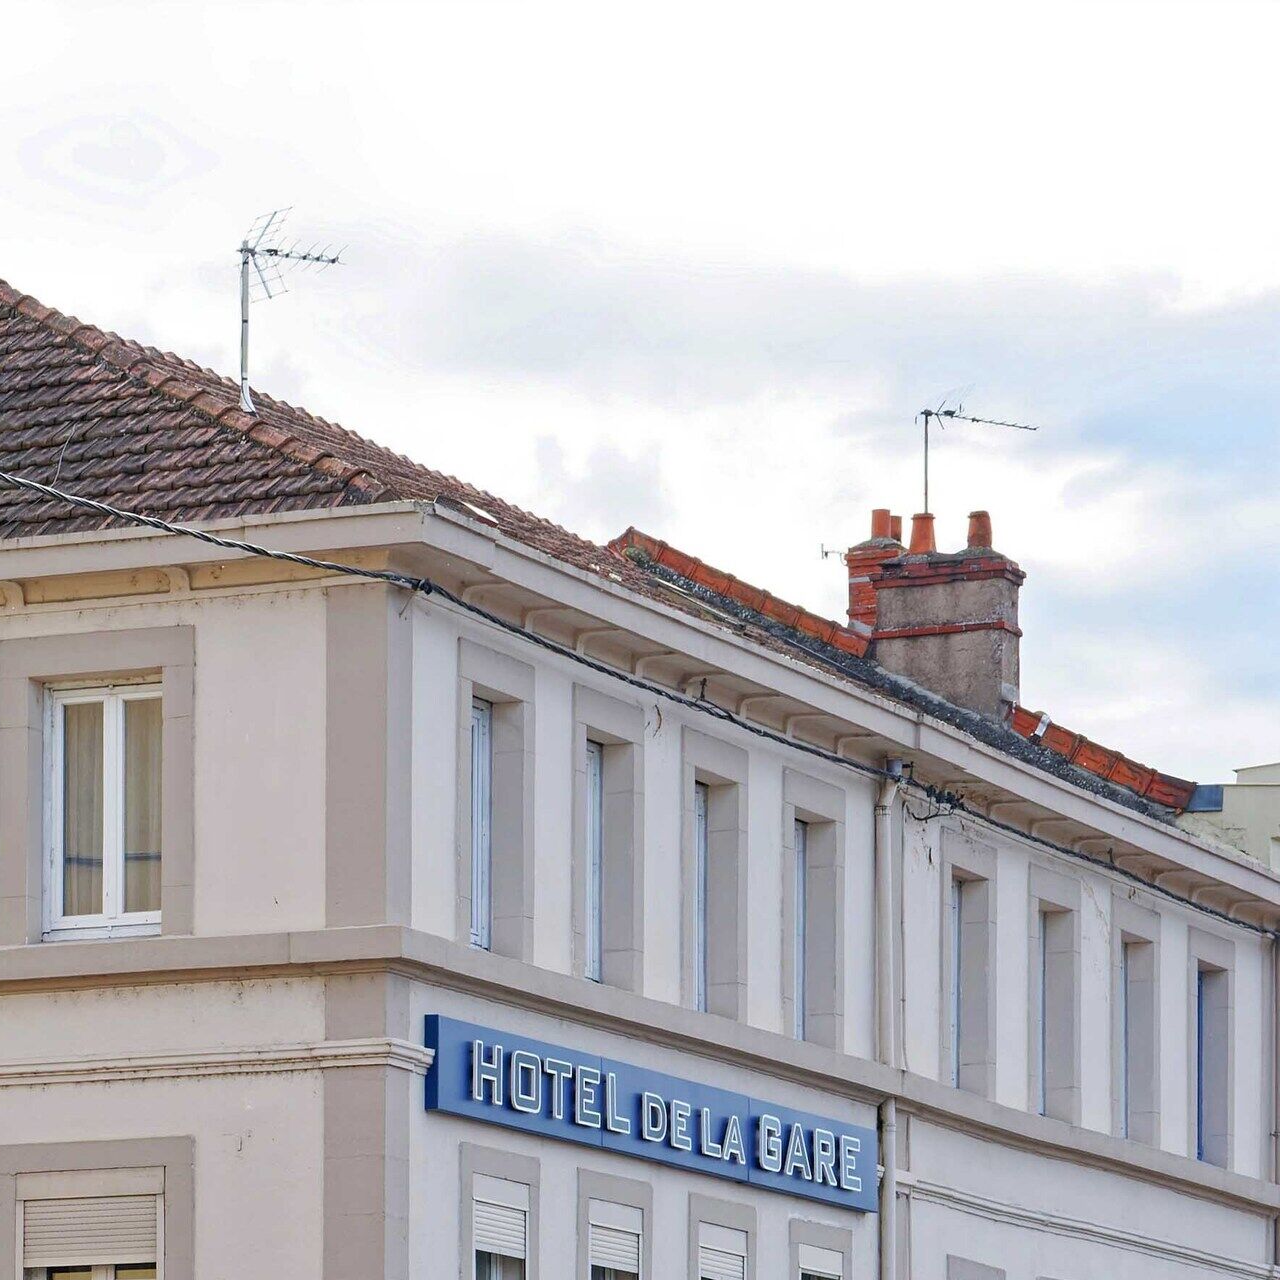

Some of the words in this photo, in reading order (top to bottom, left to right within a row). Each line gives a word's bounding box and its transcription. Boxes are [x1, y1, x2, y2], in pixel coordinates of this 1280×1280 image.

[472, 1039, 631, 1134] HOTEL
[641, 1091, 693, 1152] DE
[700, 1107, 746, 1165] LA
[757, 1113, 863, 1193] GARE
